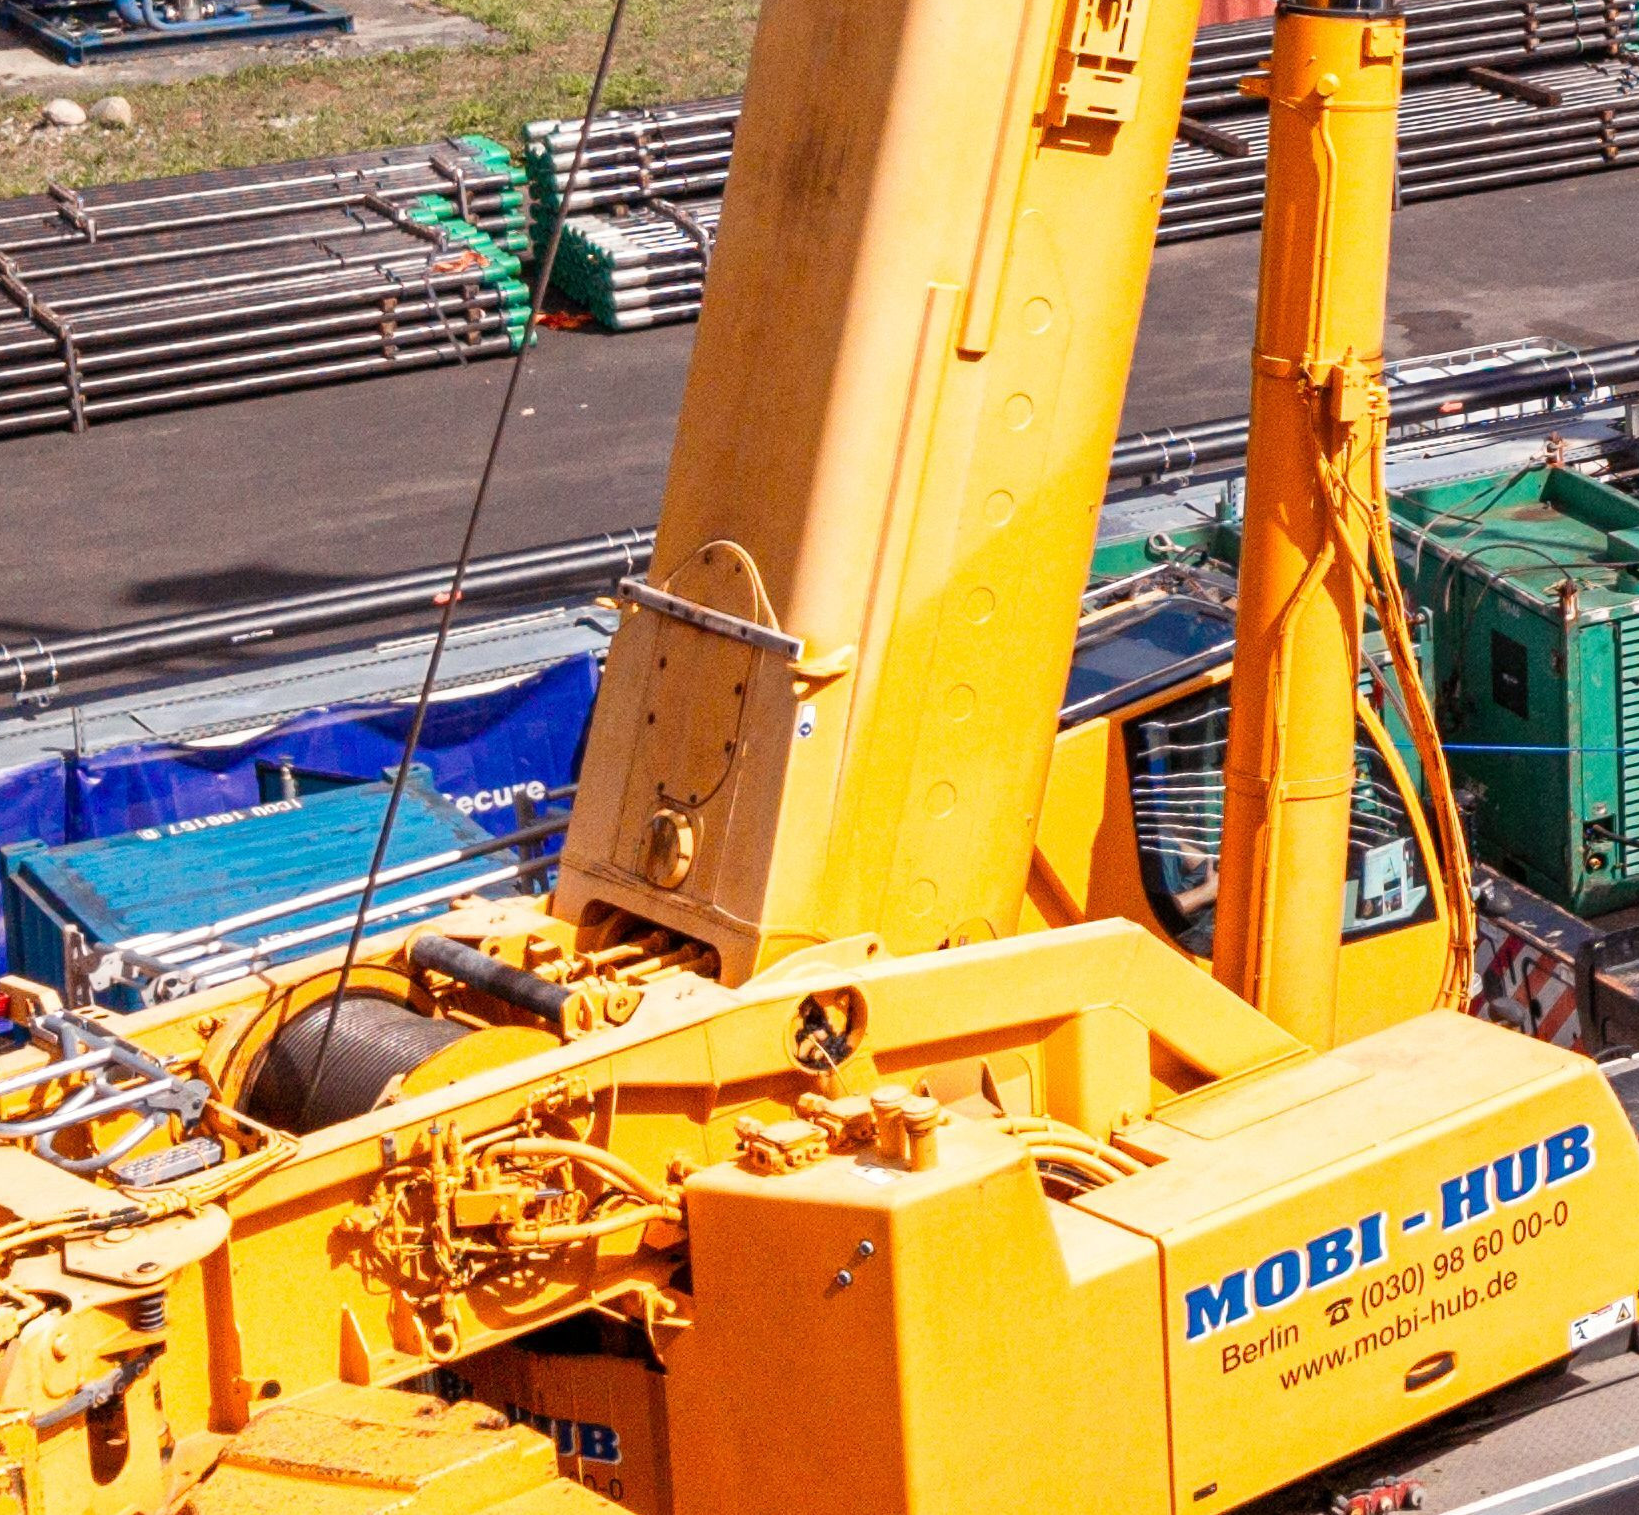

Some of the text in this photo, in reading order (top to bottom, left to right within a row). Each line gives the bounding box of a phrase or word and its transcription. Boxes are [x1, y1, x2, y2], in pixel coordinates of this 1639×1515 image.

[442, 780, 546, 815] ecure
[1185, 1211, 1389, 1343] MOBI
[1440, 1124, 1596, 1233] HUB
[1221, 1200, 1569, 1375] Berlin (030) 98 60 00-0
[1279, 1268, 1518, 1391] www.mobi-hub.de
